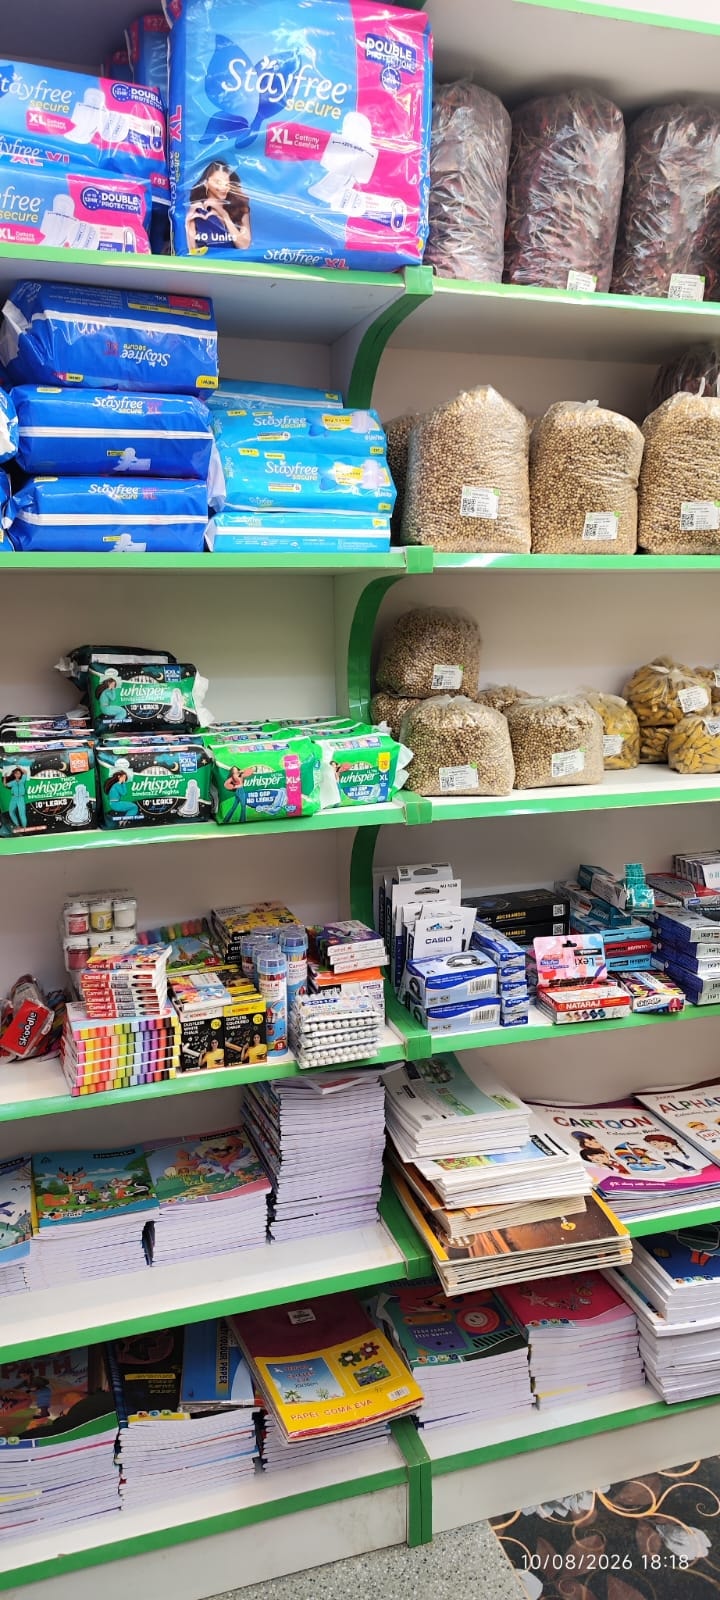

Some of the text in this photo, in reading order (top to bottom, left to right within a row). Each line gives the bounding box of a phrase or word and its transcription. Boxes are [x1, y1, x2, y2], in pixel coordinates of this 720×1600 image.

[366, 37, 412, 60] DOUBLE
[221, 58, 349, 104] Stayfree
[0, 79, 72, 104] tayfree
[131, 87, 161, 104] DOUBL
[30, 100, 70, 113] secure
[285, 98, 341, 119] secure
[28, 112, 46, 125] XL
[170, 105, 182, 142] XL
[270, 128, 293, 145] XL
[294, 134, 320, 143] Cottony
[294, 141, 320, 150] Comfort
[101, 192, 139, 205] DOUBLE
[101, 201, 139, 211] PROTECTION
[211, 231, 237, 241] Units
[264, 249, 320, 264] Stayfree
[121, 349, 171, 367] Stayfree
[92, 396, 143, 410] Stayfree
[253, 415, 307, 427] Stayfree
[265, 460, 318, 477] Stayfree
[88, 483, 139, 497] Stayfree
[120, 684, 165, 698] whisper
[131, 776, 181, 794] whisper
[243, 775, 282, 788] whisper
[340, 772, 375, 785] whisper
[27, 780, 75, 796] whisper
[425, 936, 452, 945] CASIO
[574, 957, 594, 966] Lexi
[566, 1000, 601, 1010] NATARAJ
[18, 1012, 37, 1046] Skoodle
[552, 1116, 654, 1130] CARTOON
[290, 1400, 374, 1422] PAPEL GOMA EVA
